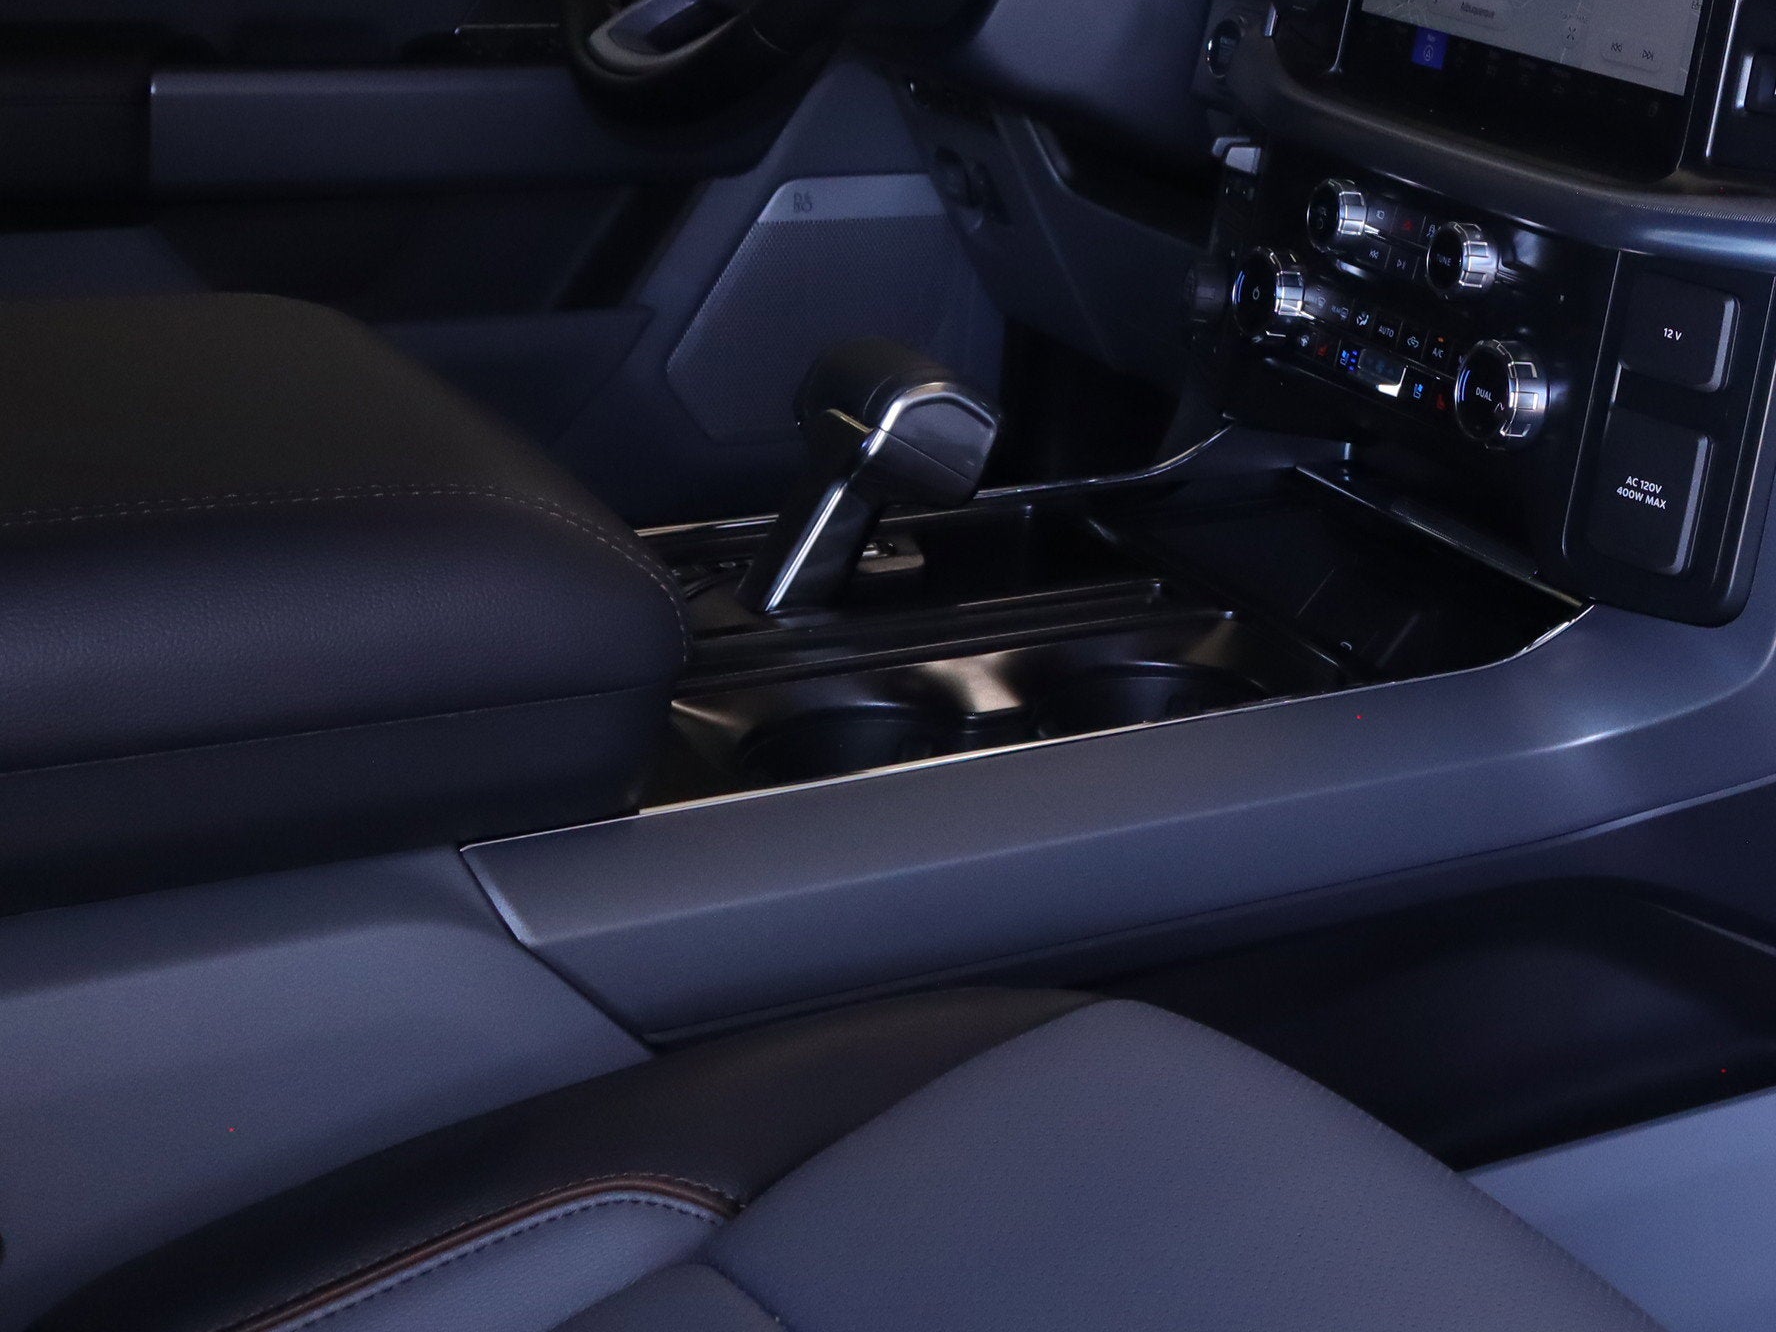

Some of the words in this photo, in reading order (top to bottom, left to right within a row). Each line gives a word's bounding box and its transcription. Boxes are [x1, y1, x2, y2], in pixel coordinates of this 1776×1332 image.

[1378, 325, 1394, 339] AUTO
[1663, 327, 1674, 339] 12
[1675, 330, 1683, 341] V
[1431, 347, 1444, 358] A/C
[1475, 386, 1493, 402] DUAL
[1625, 476, 1639, 487] AC
[1640, 480, 1662, 494] 120V
[1616, 486, 1644, 502] 400W
[1645, 494, 1667, 510] MAX
